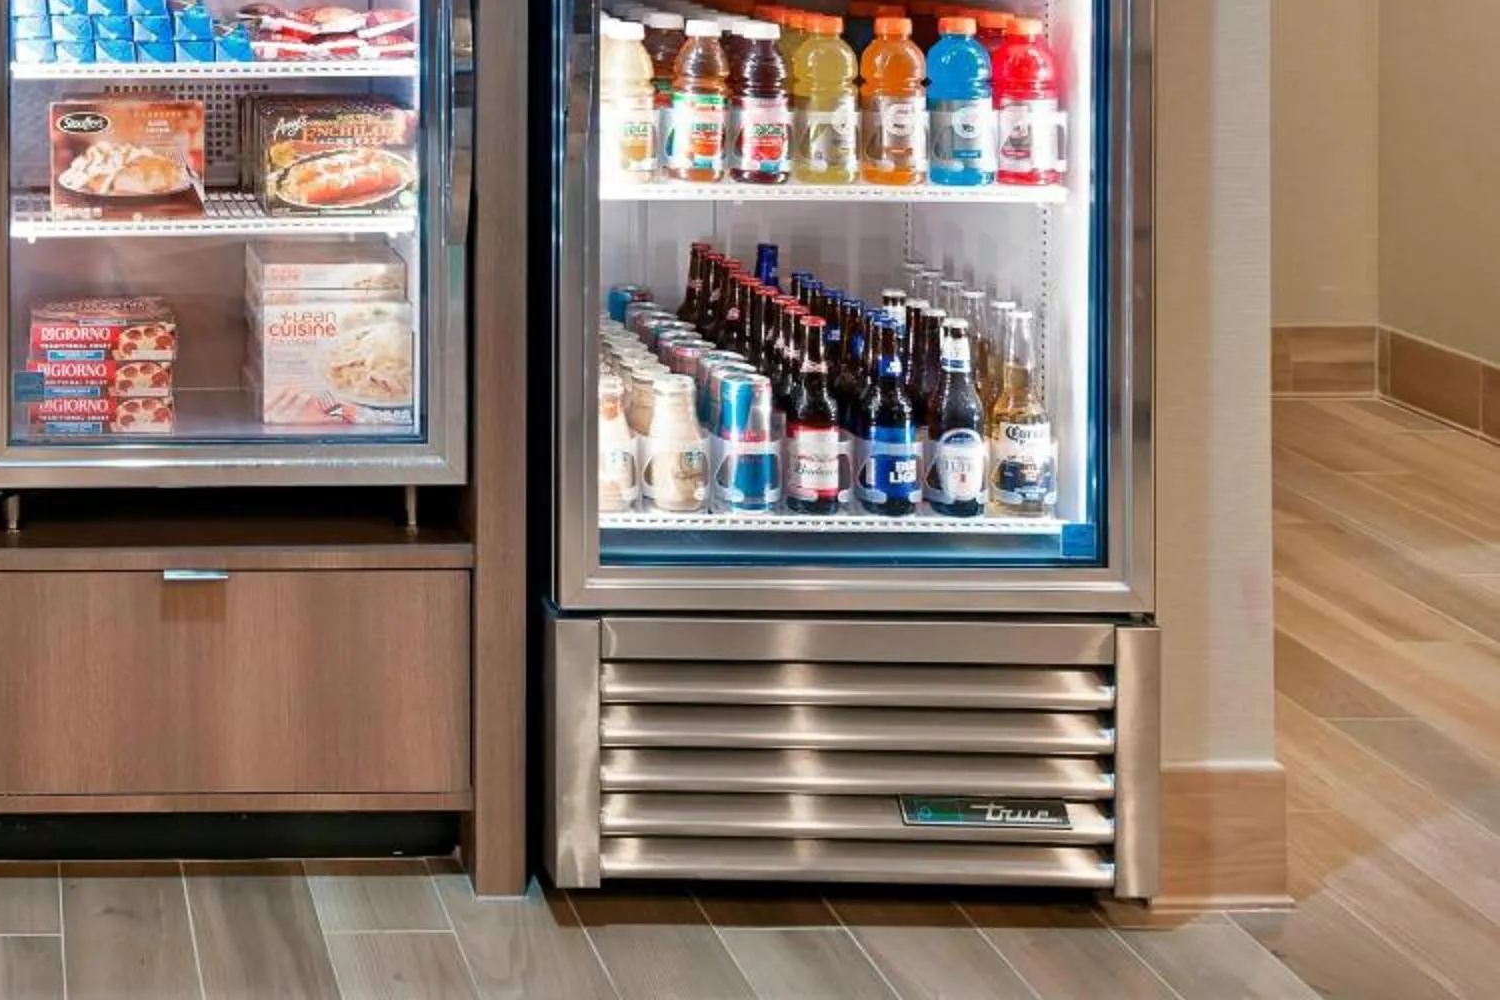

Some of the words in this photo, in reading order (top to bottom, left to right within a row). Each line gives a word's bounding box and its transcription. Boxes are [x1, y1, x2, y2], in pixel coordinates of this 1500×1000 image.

[291, 310, 338, 324] Lean
[41, 327, 110, 343] DIGIORNO
[268, 320, 338, 338] cuisine
[970, 803, 1063, 824] true
